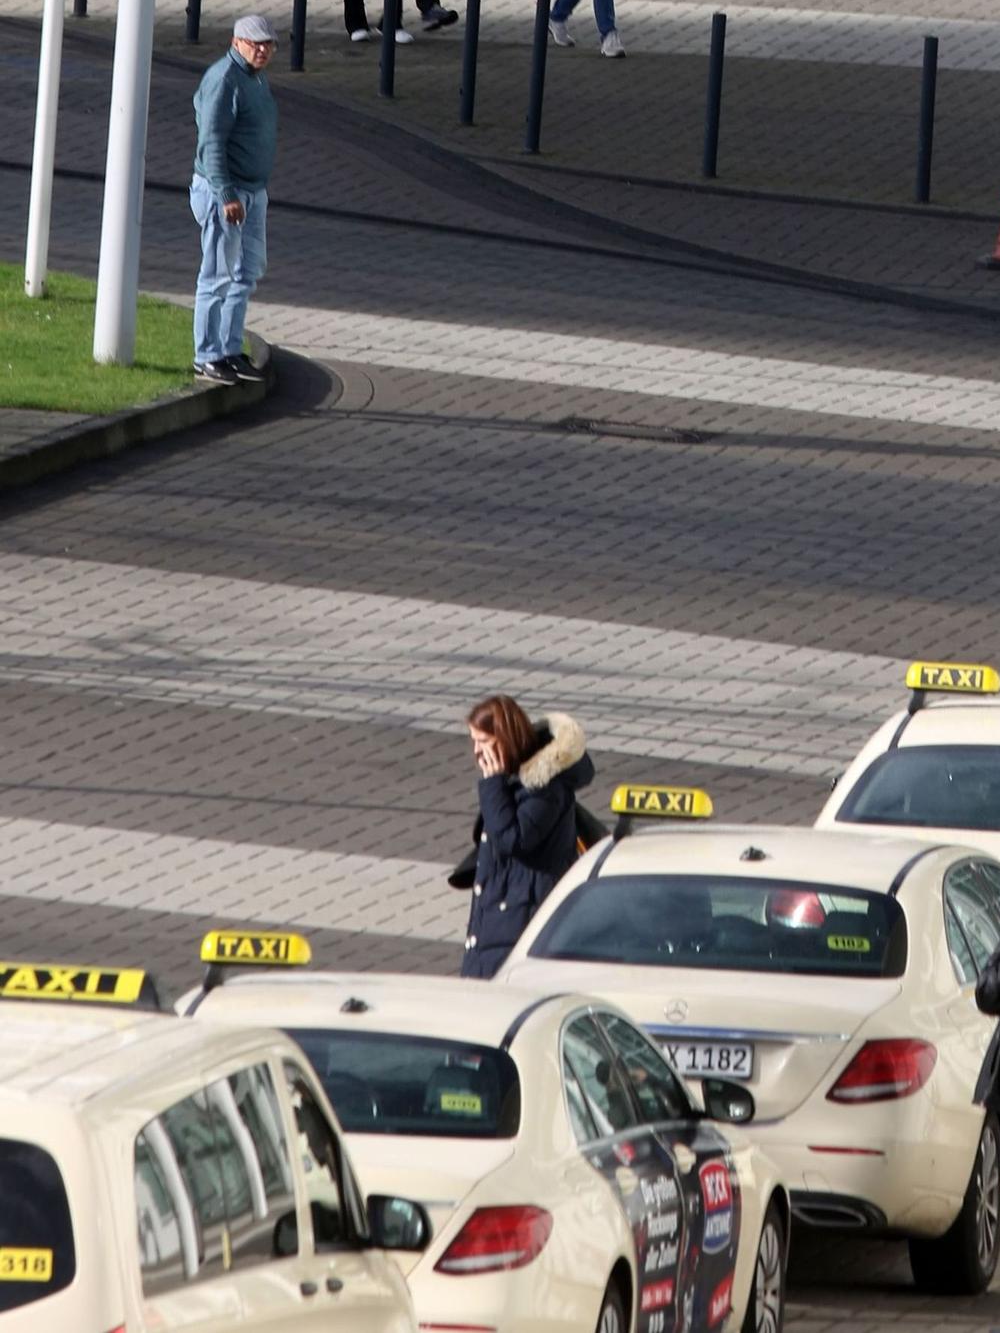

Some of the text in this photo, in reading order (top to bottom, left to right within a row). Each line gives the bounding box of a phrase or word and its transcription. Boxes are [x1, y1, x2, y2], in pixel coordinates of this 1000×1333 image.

[923, 667, 982, 688] TAXI
[629, 790, 692, 812] TAXI
[218, 935, 288, 960] TAXI
[687, 1046, 747, 1071] 1182
